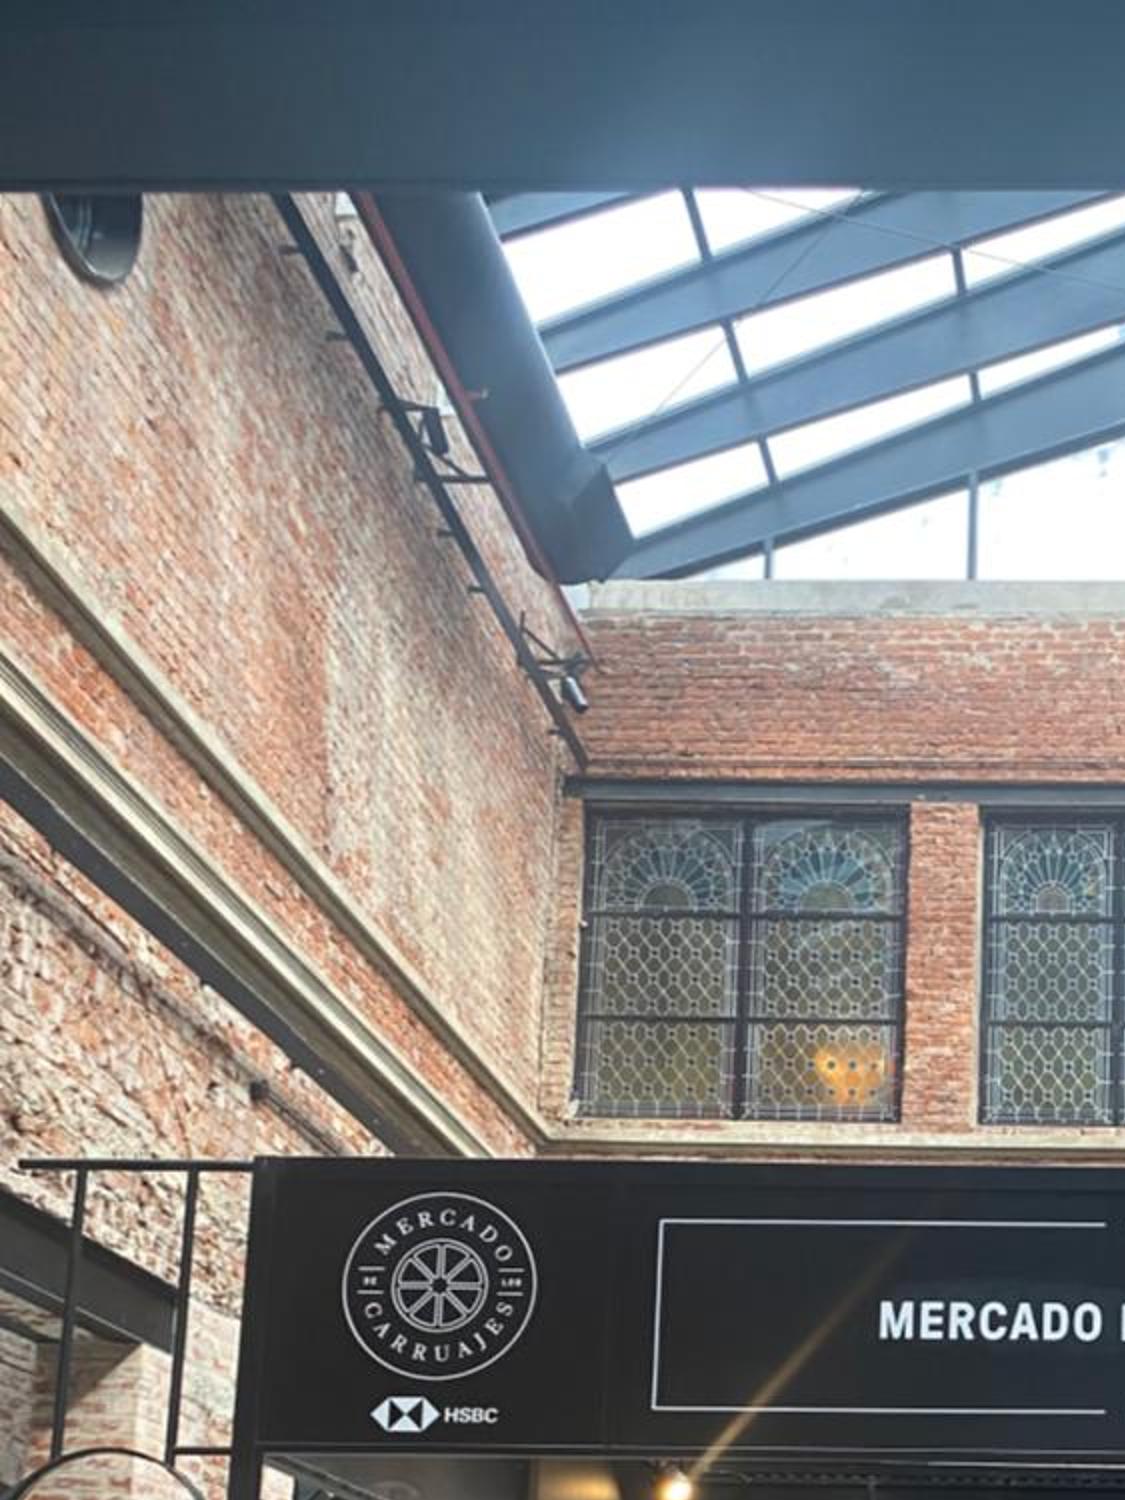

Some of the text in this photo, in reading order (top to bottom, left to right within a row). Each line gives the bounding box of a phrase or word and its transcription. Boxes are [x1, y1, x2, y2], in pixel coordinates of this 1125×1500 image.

[374, 1208, 513, 1262] MERCADO
[364, 1301, 514, 1363] CARRUAJES
[879, 1300, 1103, 1342] MERCADO
[443, 1407, 500, 1424] HSBC
